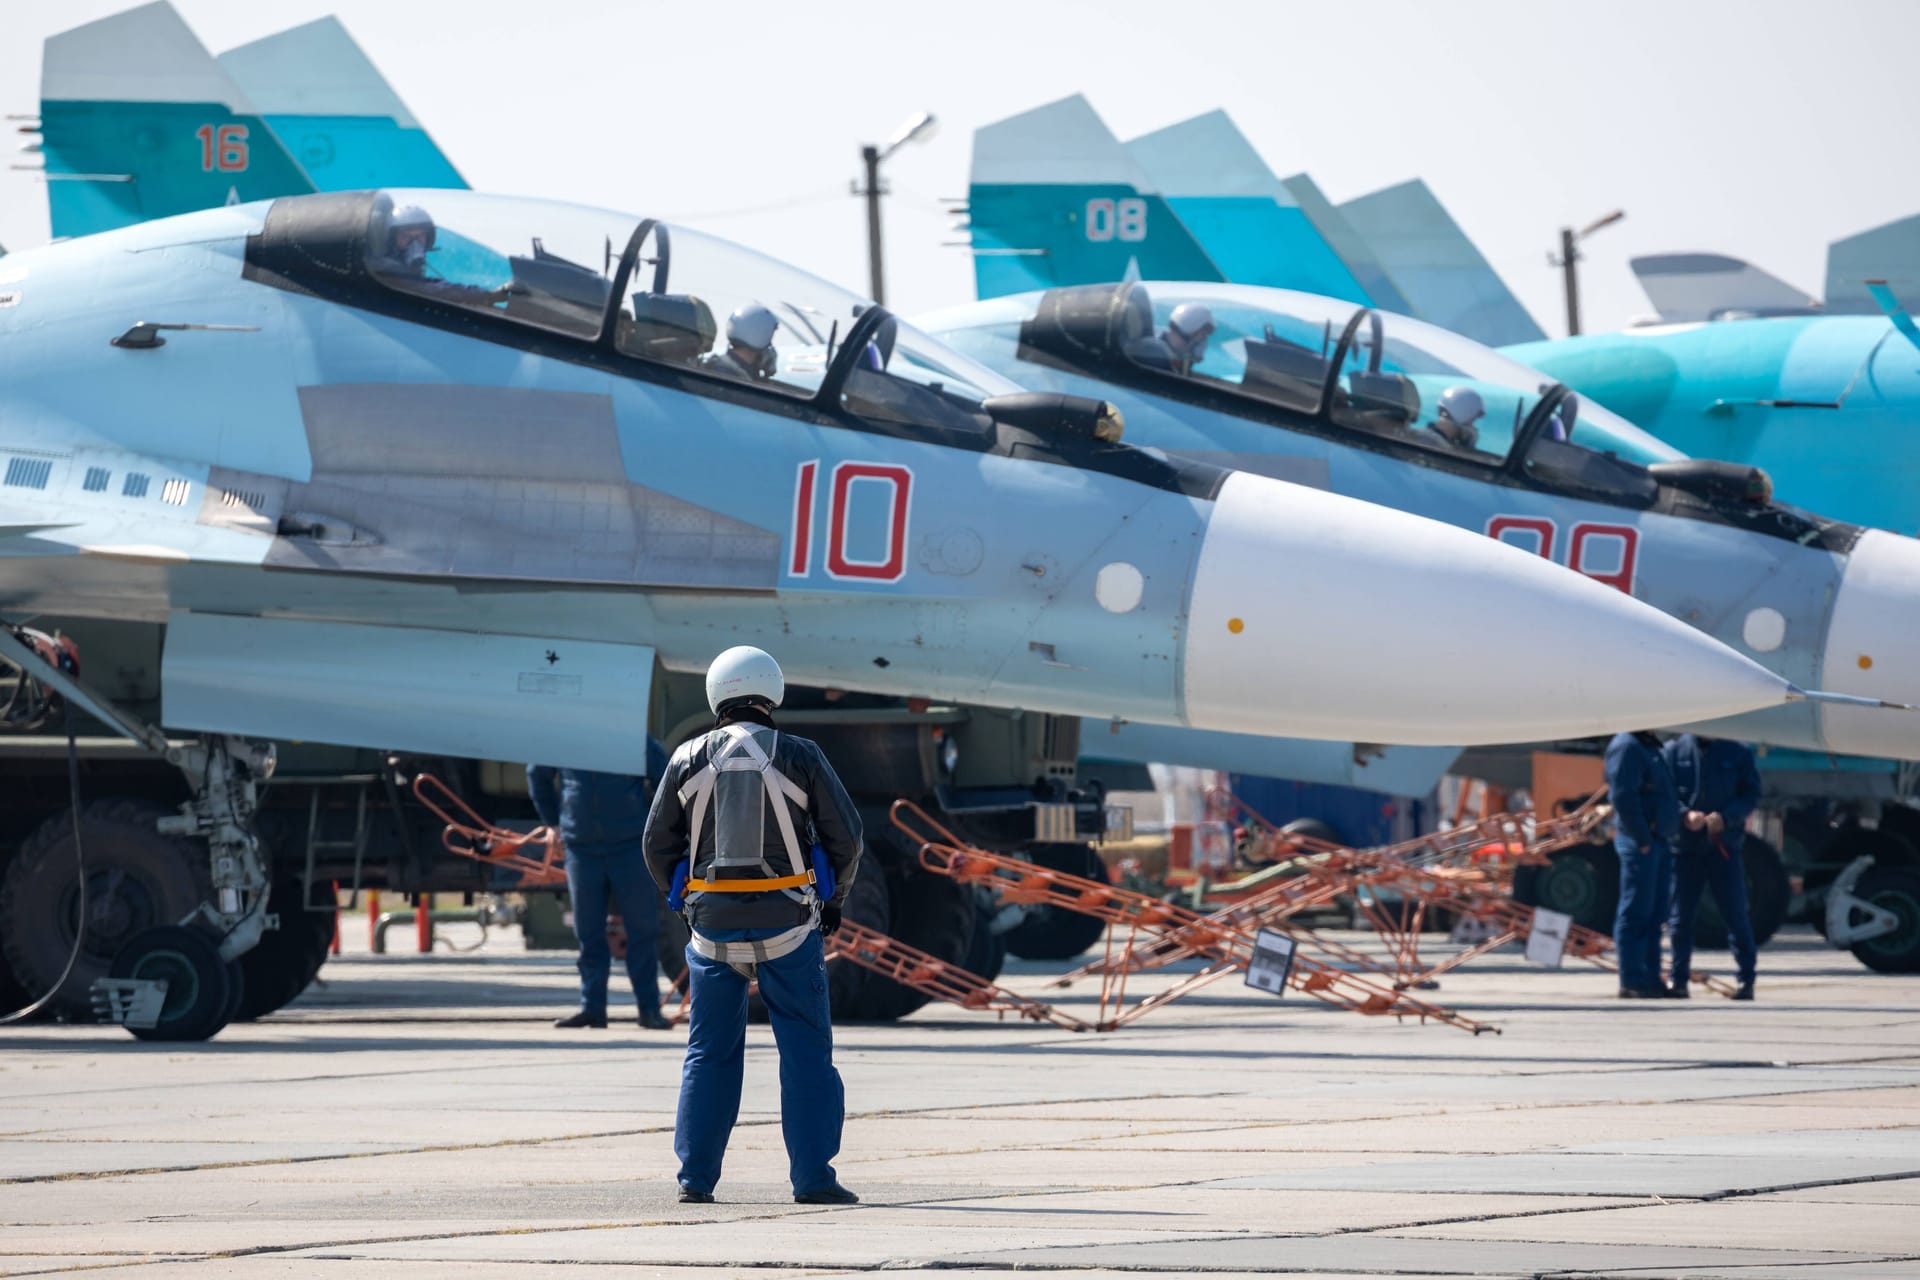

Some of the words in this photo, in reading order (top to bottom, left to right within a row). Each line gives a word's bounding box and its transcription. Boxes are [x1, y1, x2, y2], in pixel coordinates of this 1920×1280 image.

[196, 123, 249, 172] 16
[1085, 198, 1147, 242] 08
[787, 458, 914, 584] 10
